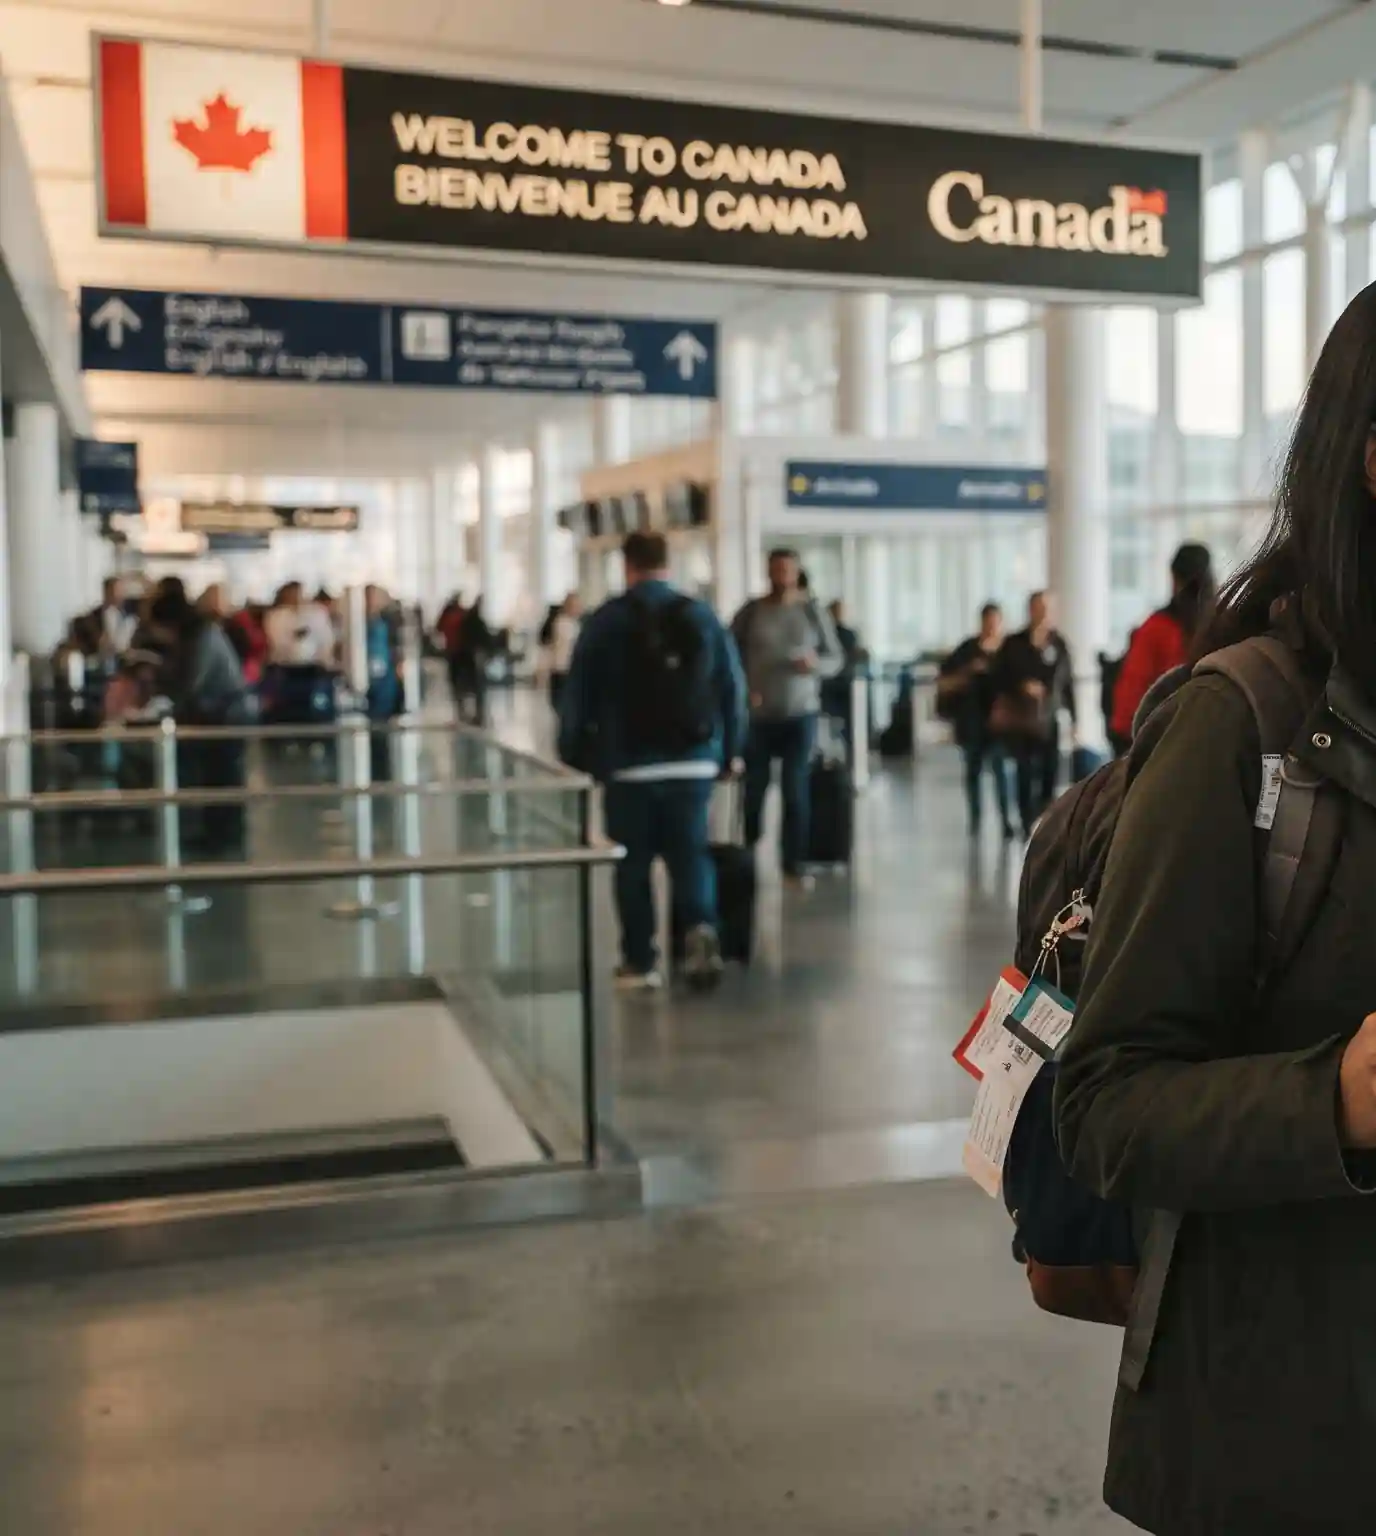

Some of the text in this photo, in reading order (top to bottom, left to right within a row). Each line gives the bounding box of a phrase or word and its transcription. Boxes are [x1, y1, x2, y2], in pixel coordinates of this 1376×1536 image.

[391, 111, 847, 192] WELCOME TO CANADA
[394, 163, 868, 241] BIENVENUE AU CANADA
[927, 170, 1168, 257] Canada
